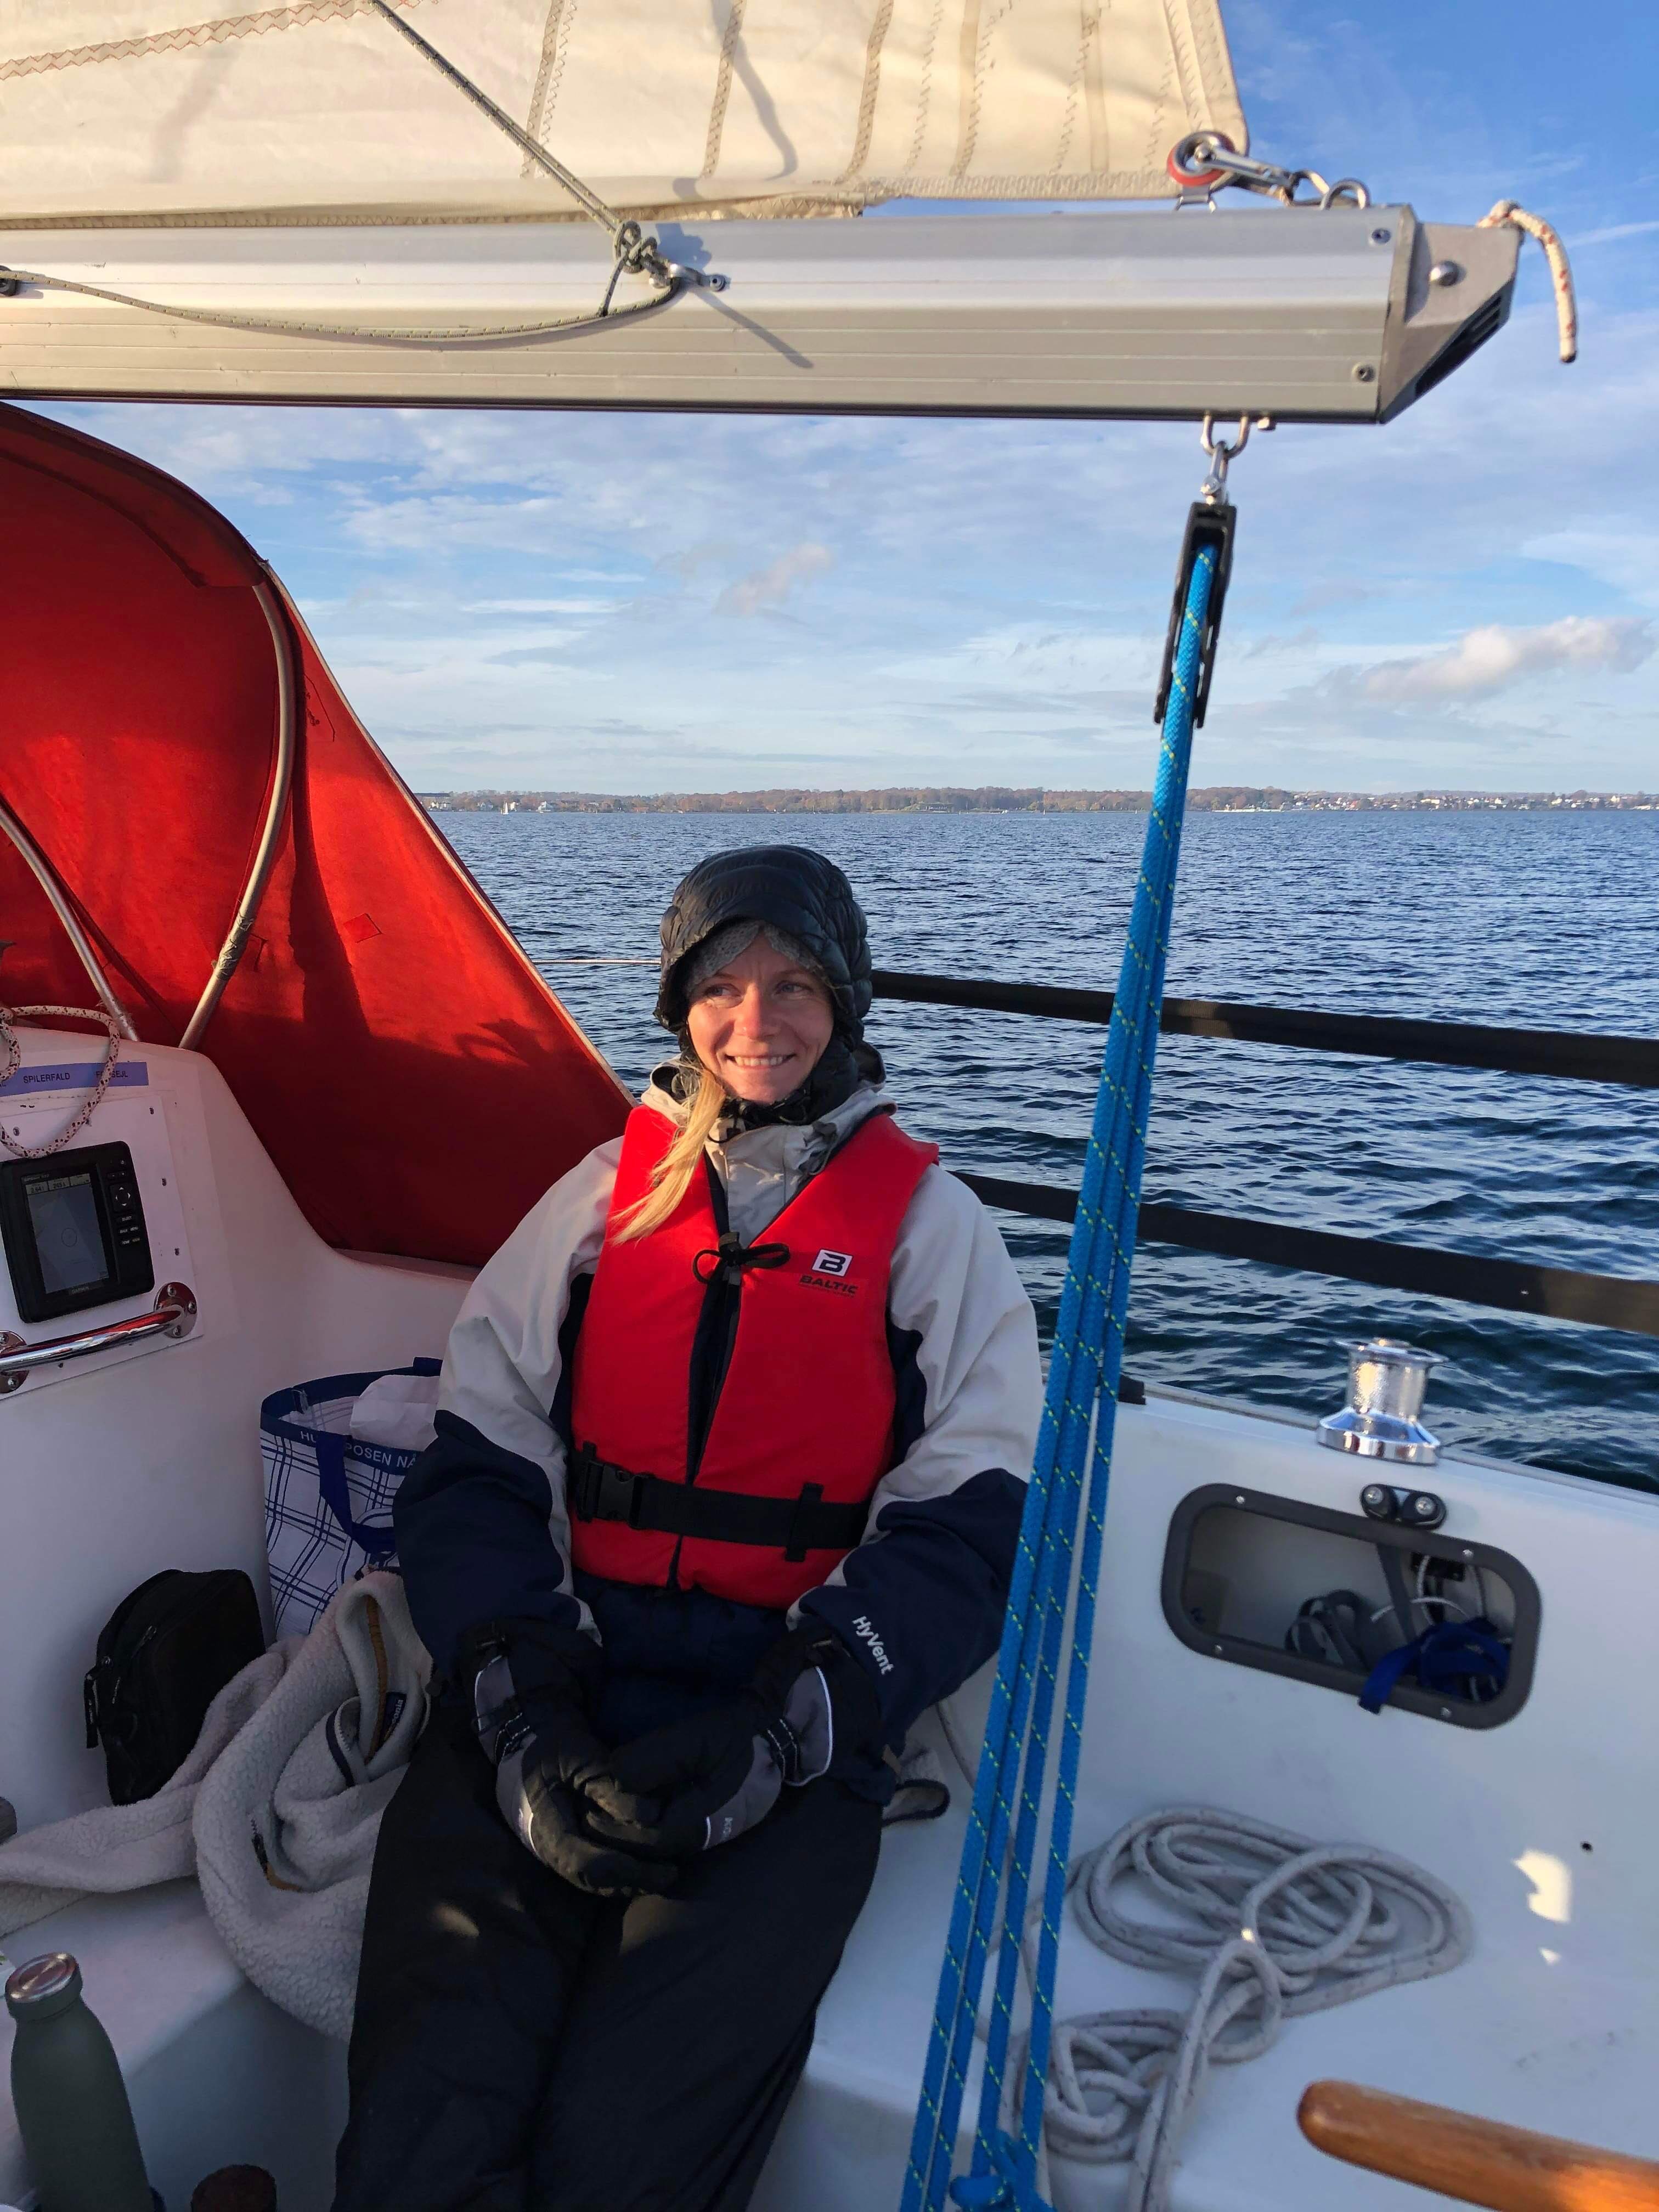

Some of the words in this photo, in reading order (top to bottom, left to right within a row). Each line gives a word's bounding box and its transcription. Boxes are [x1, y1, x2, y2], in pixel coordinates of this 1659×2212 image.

[23, 1072, 70, 1084] SPILERFALD
[799, 1275, 858, 1294] BALTIC
[397, 1451, 417, 1469] NÅ
[851, 1616, 894, 1677] HyVent
